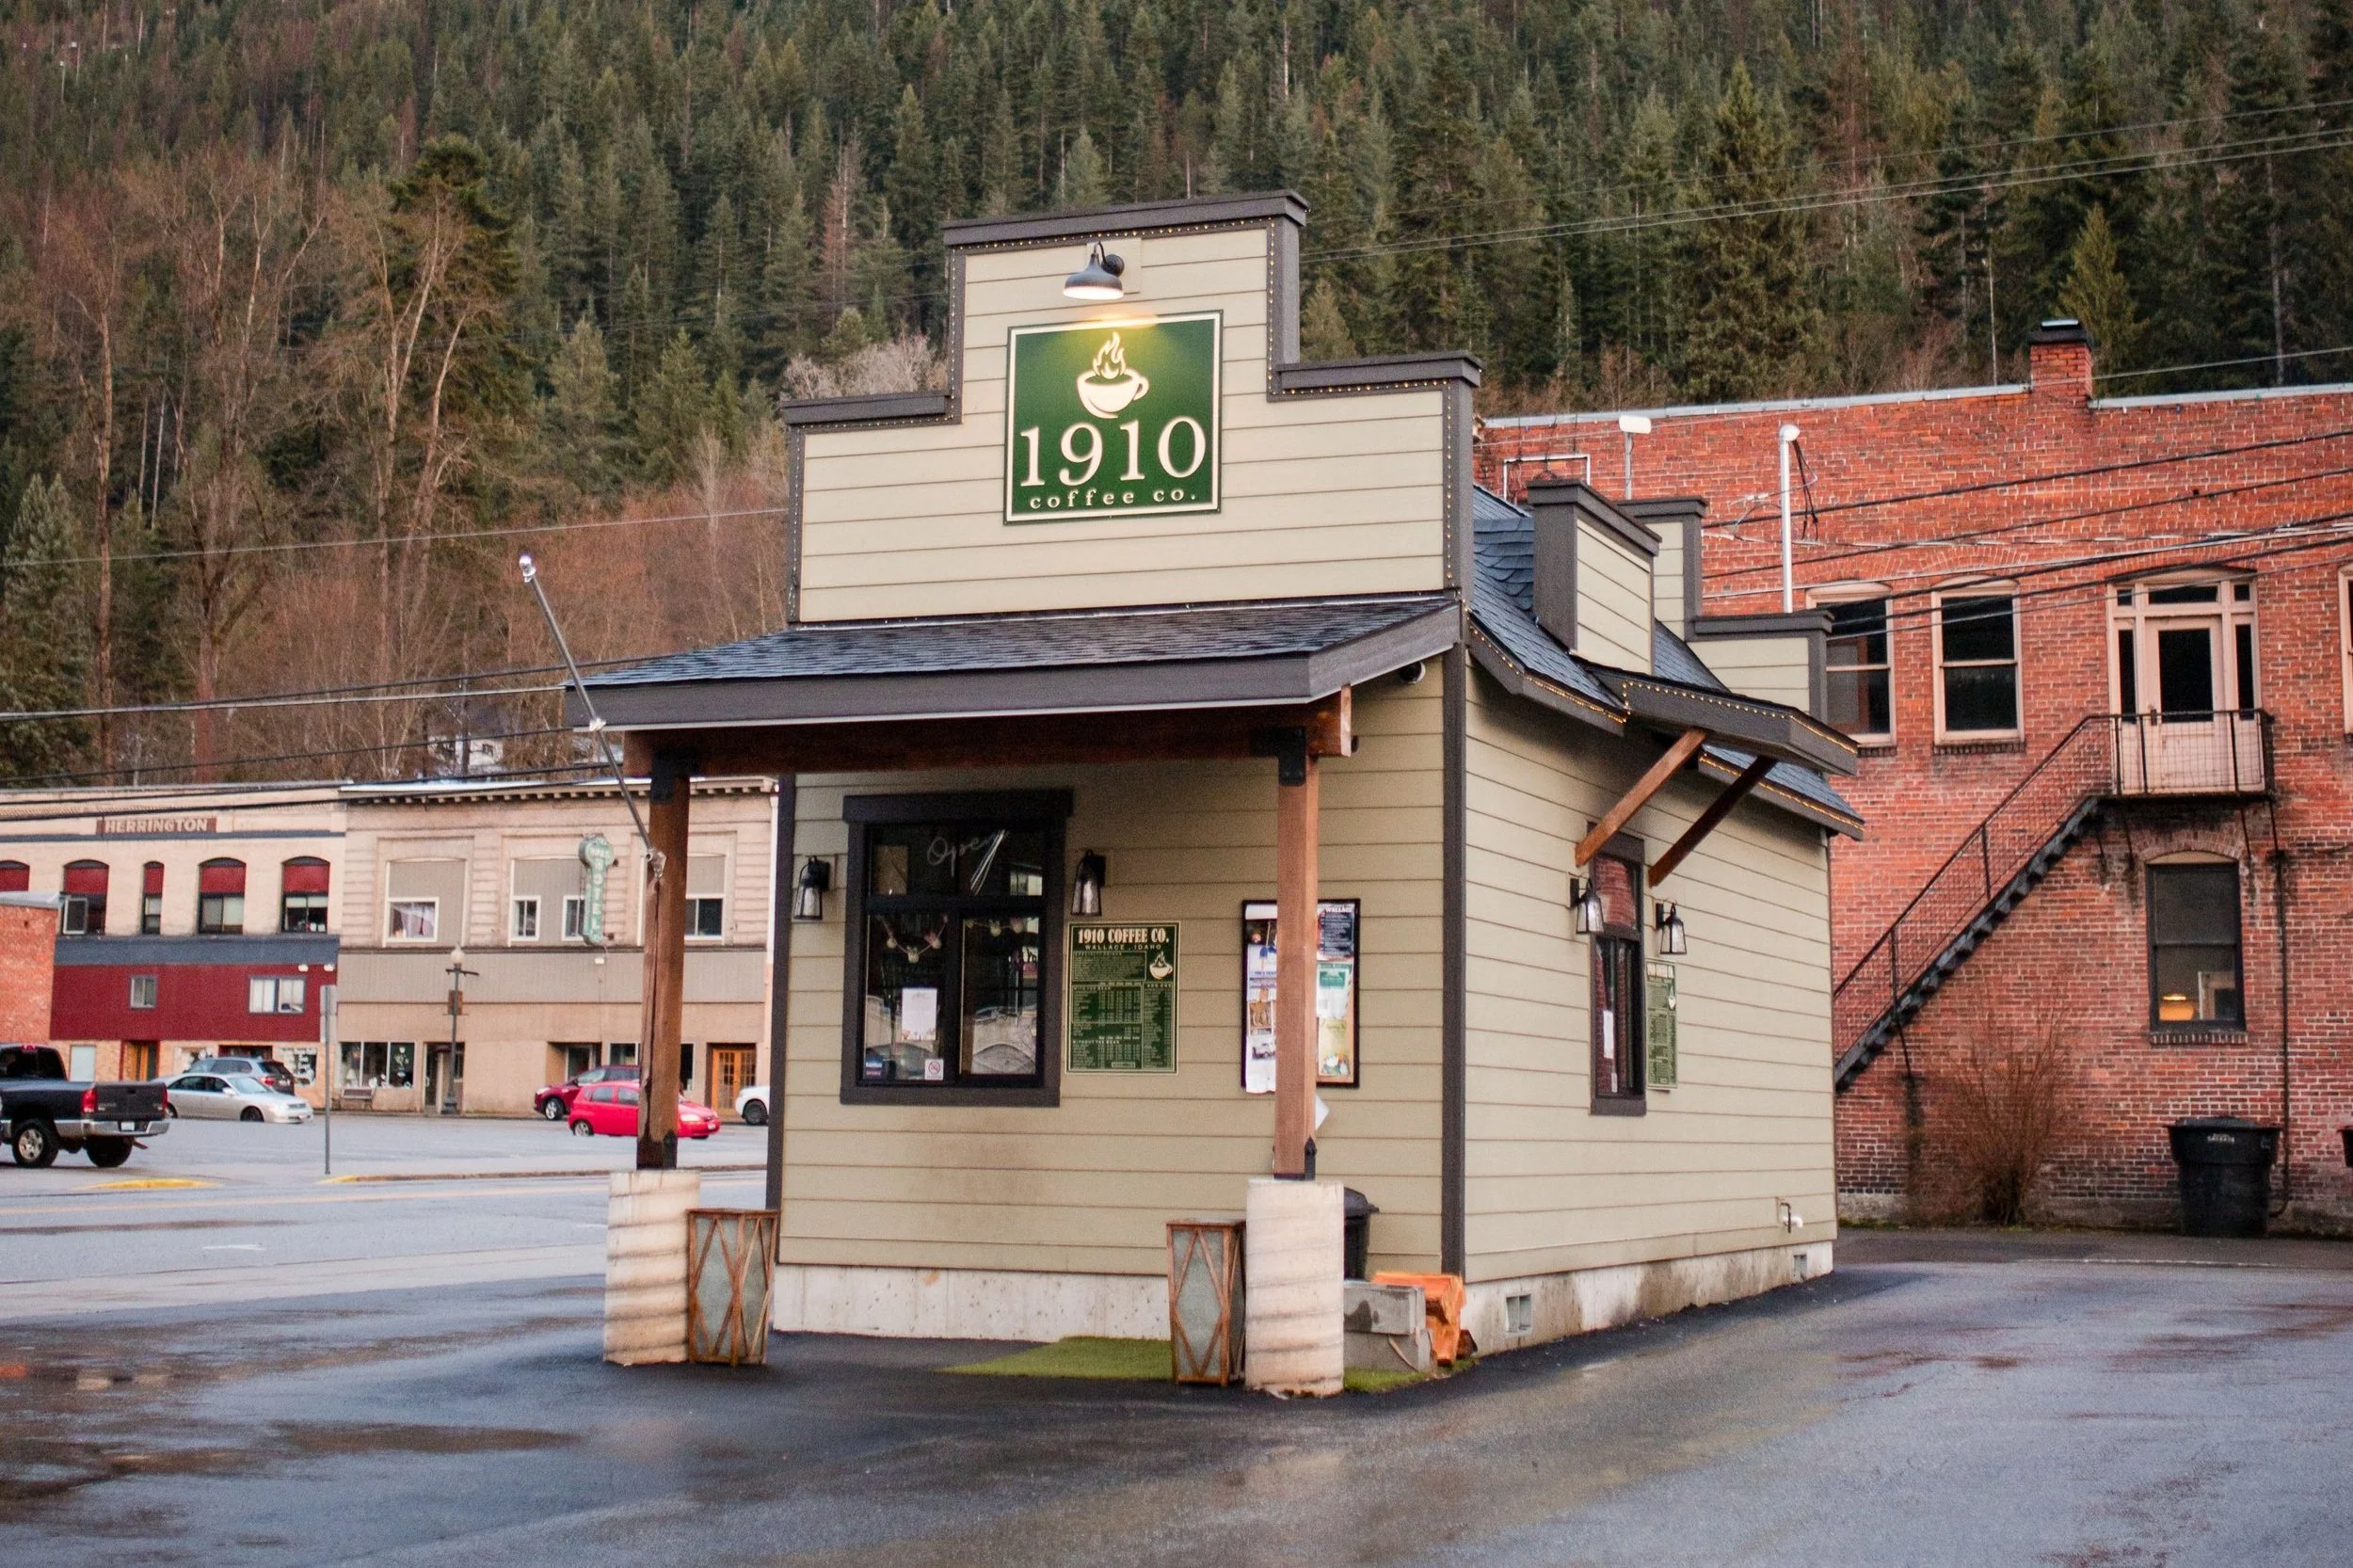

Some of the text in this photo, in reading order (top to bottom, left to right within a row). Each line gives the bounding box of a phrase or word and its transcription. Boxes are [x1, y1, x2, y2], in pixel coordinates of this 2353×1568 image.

[1020, 416, 1207, 487] 1910
[1030, 488, 1196, 509] coffee co.
[104, 819, 207, 833] HERRINGTON
[1078, 928, 1169, 944] 1910 COFFEE CO.
